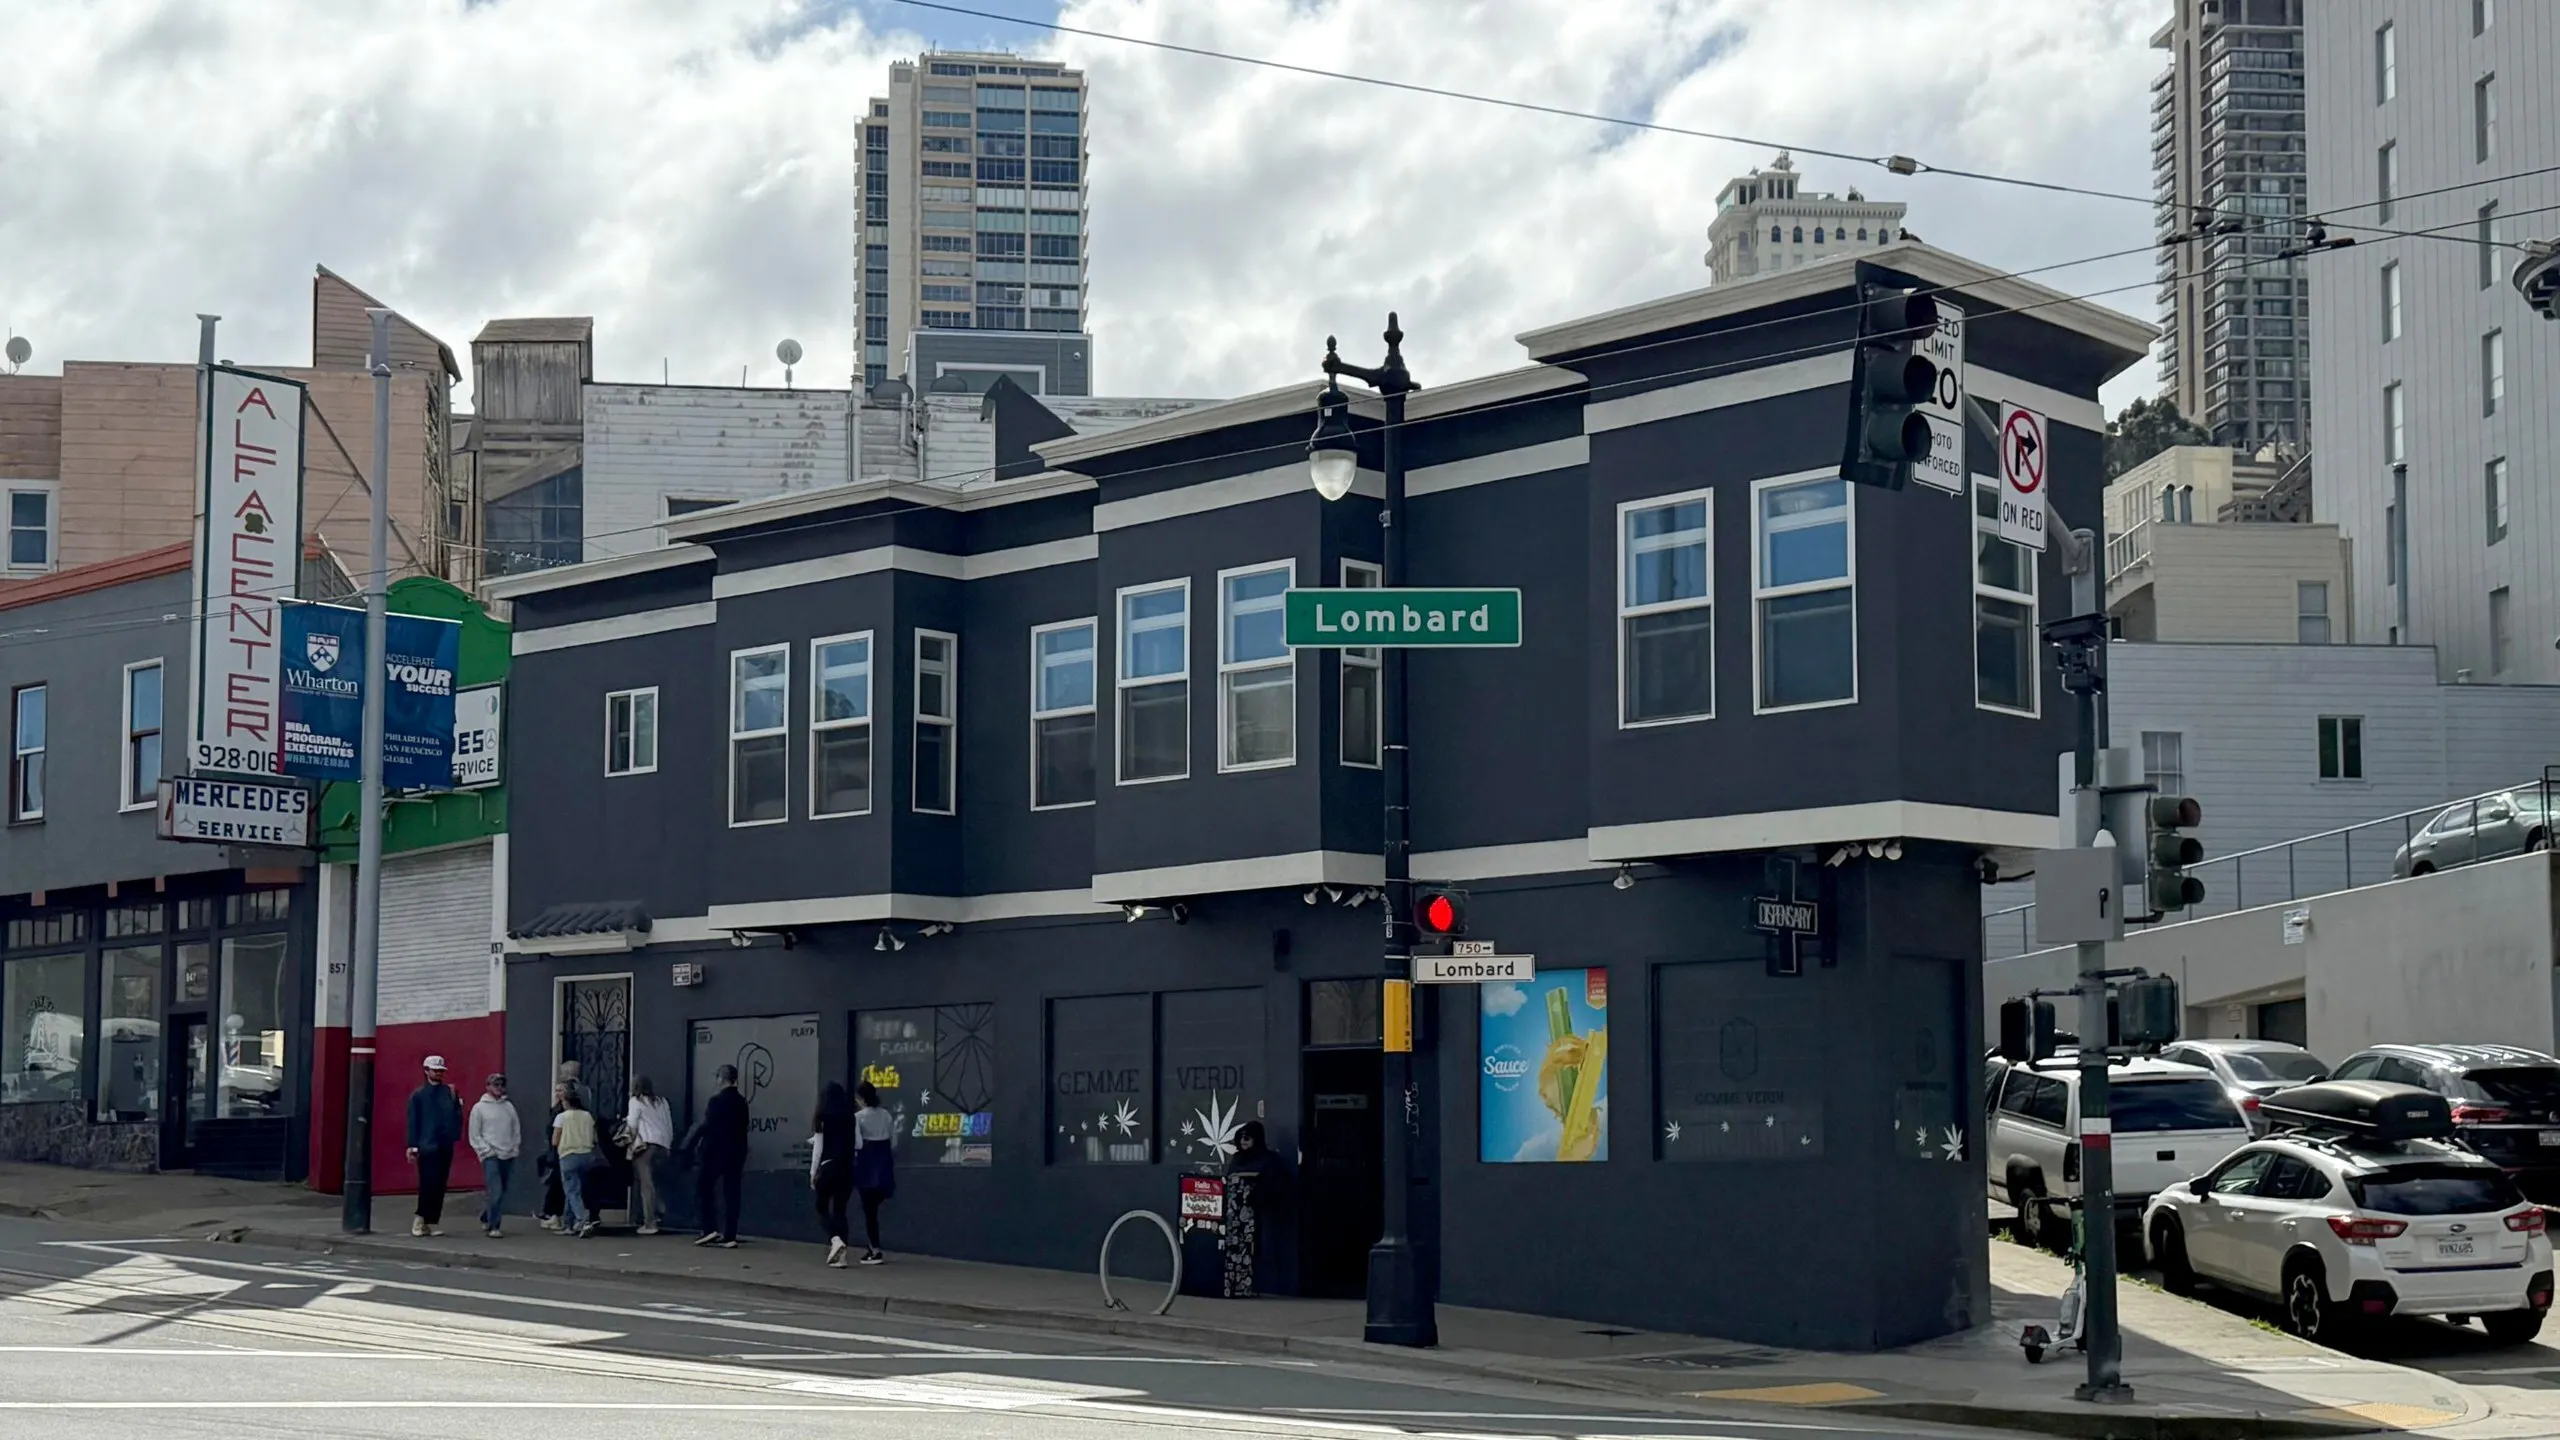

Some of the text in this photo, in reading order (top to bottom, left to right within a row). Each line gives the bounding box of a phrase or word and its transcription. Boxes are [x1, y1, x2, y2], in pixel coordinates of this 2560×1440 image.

[1923, 337, 1955, 361] LIMIT
[1931, 432, 1953, 450] HOTO
[1918, 454, 1961, 477] NFORCED
[2002, 502, 2044, 532] ON RED
[226, 386, 277, 742] ALFA CENTER
[1315, 603, 1490, 633] Lombard
[385, 654, 436, 668] ACCELERATE
[286, 667, 358, 694] Wharton
[386, 663, 452, 687] YOUR
[406, 684, 451, 697] SUCCESS
[285, 721, 311, 734] MBA
[284, 731, 341, 747] PROGRAM
[384, 733, 440, 746] PHILADELPHIA
[284, 741, 354, 758] EXECUTIVES
[383, 744, 443, 757] SAN FRANCISCO
[383, 755, 414, 765] GLOBAL
[452, 757, 495, 777] ERVICE
[175, 780, 306, 815] MERCEDES
[197, 820, 284, 842] SERVICE
[1759, 902, 1813, 930] DISPENSARY
[1457, 943, 1482, 954] 750
[1434, 960, 1515, 977] Lombard
[1484, 1055, 1528, 1075] Sauce
[1057, 1064, 1245, 1095] GEMME VERDI
